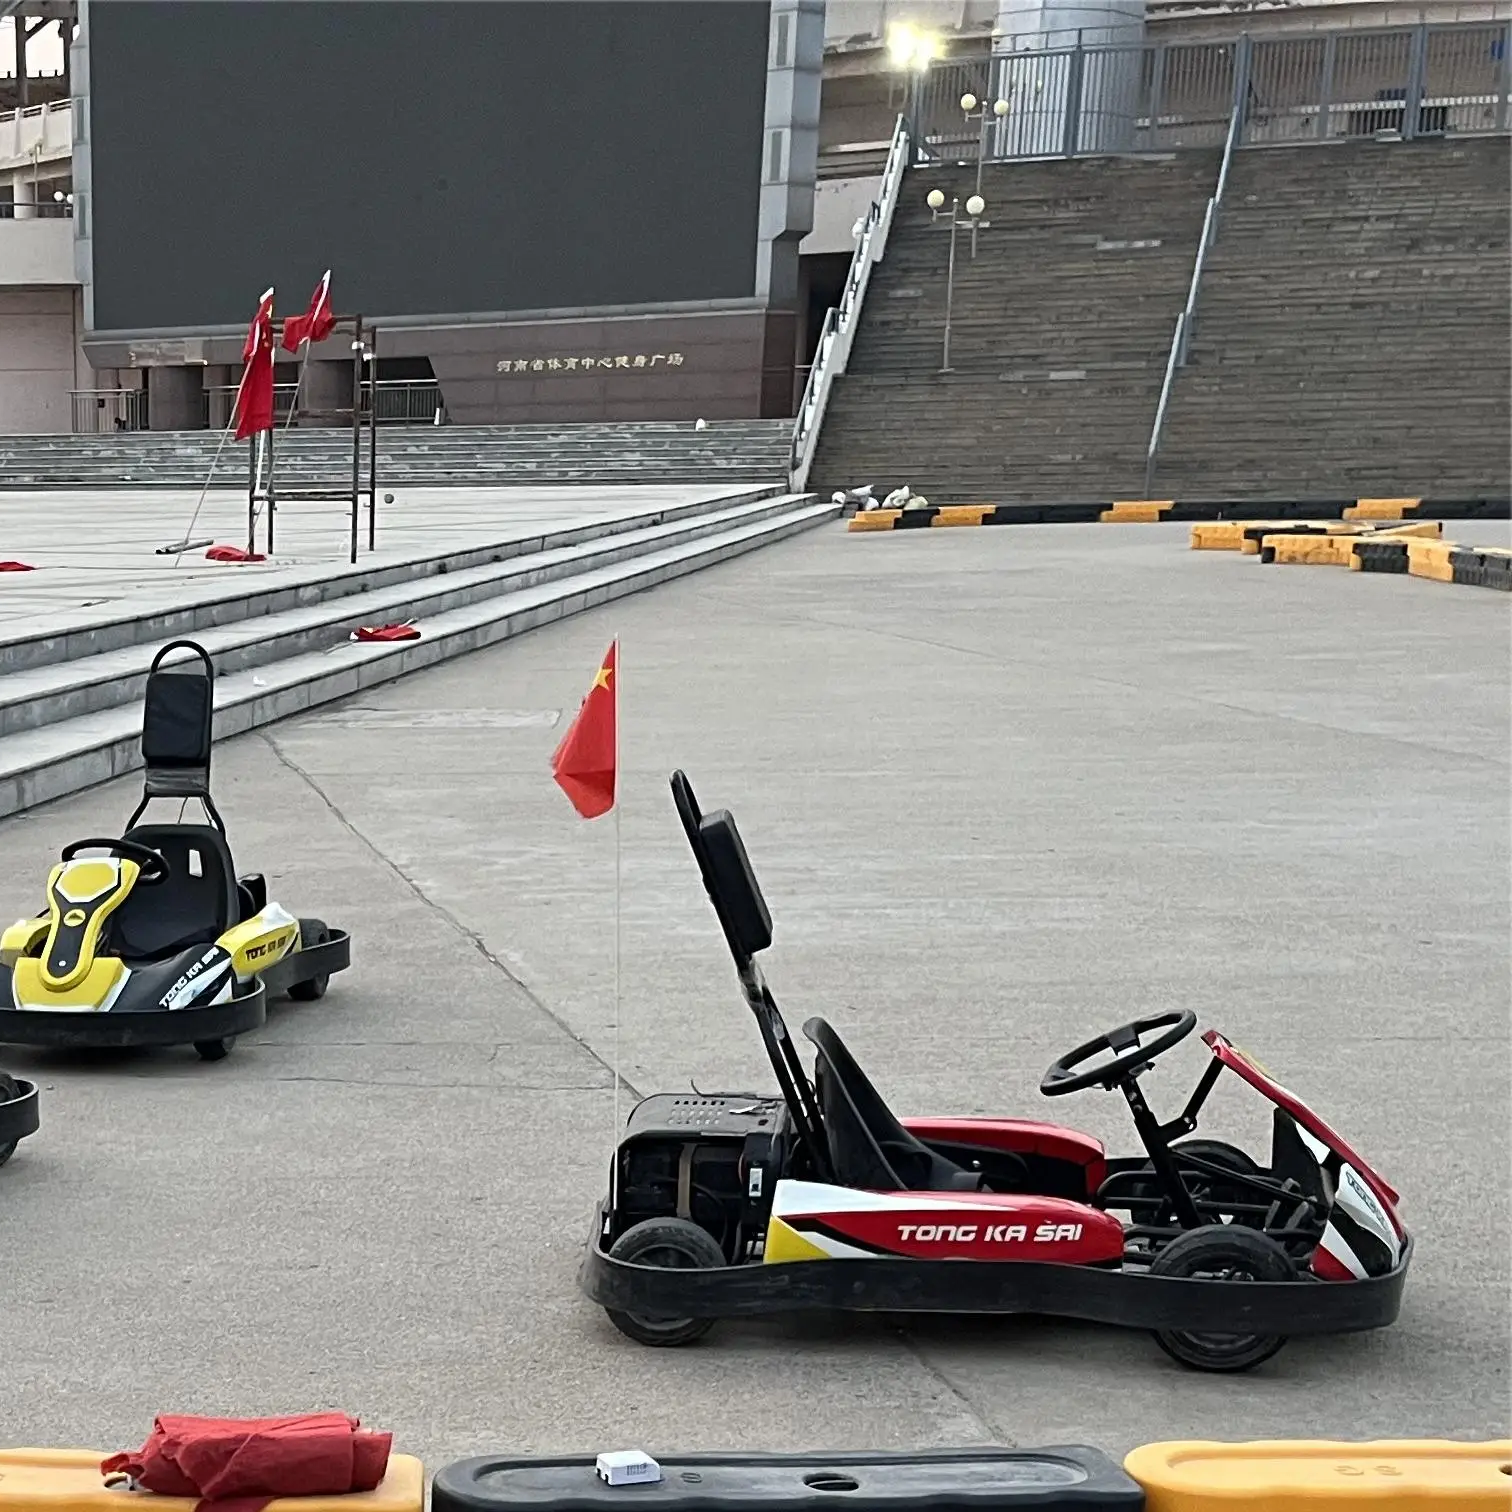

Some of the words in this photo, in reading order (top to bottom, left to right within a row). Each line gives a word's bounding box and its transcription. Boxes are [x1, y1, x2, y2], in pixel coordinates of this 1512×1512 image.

[158, 975, 188, 1007] TONG
[897, 1225, 978, 1242] TONG
[983, 1225, 1028, 1243] KA
[1033, 1223, 1084, 1243] SAI
